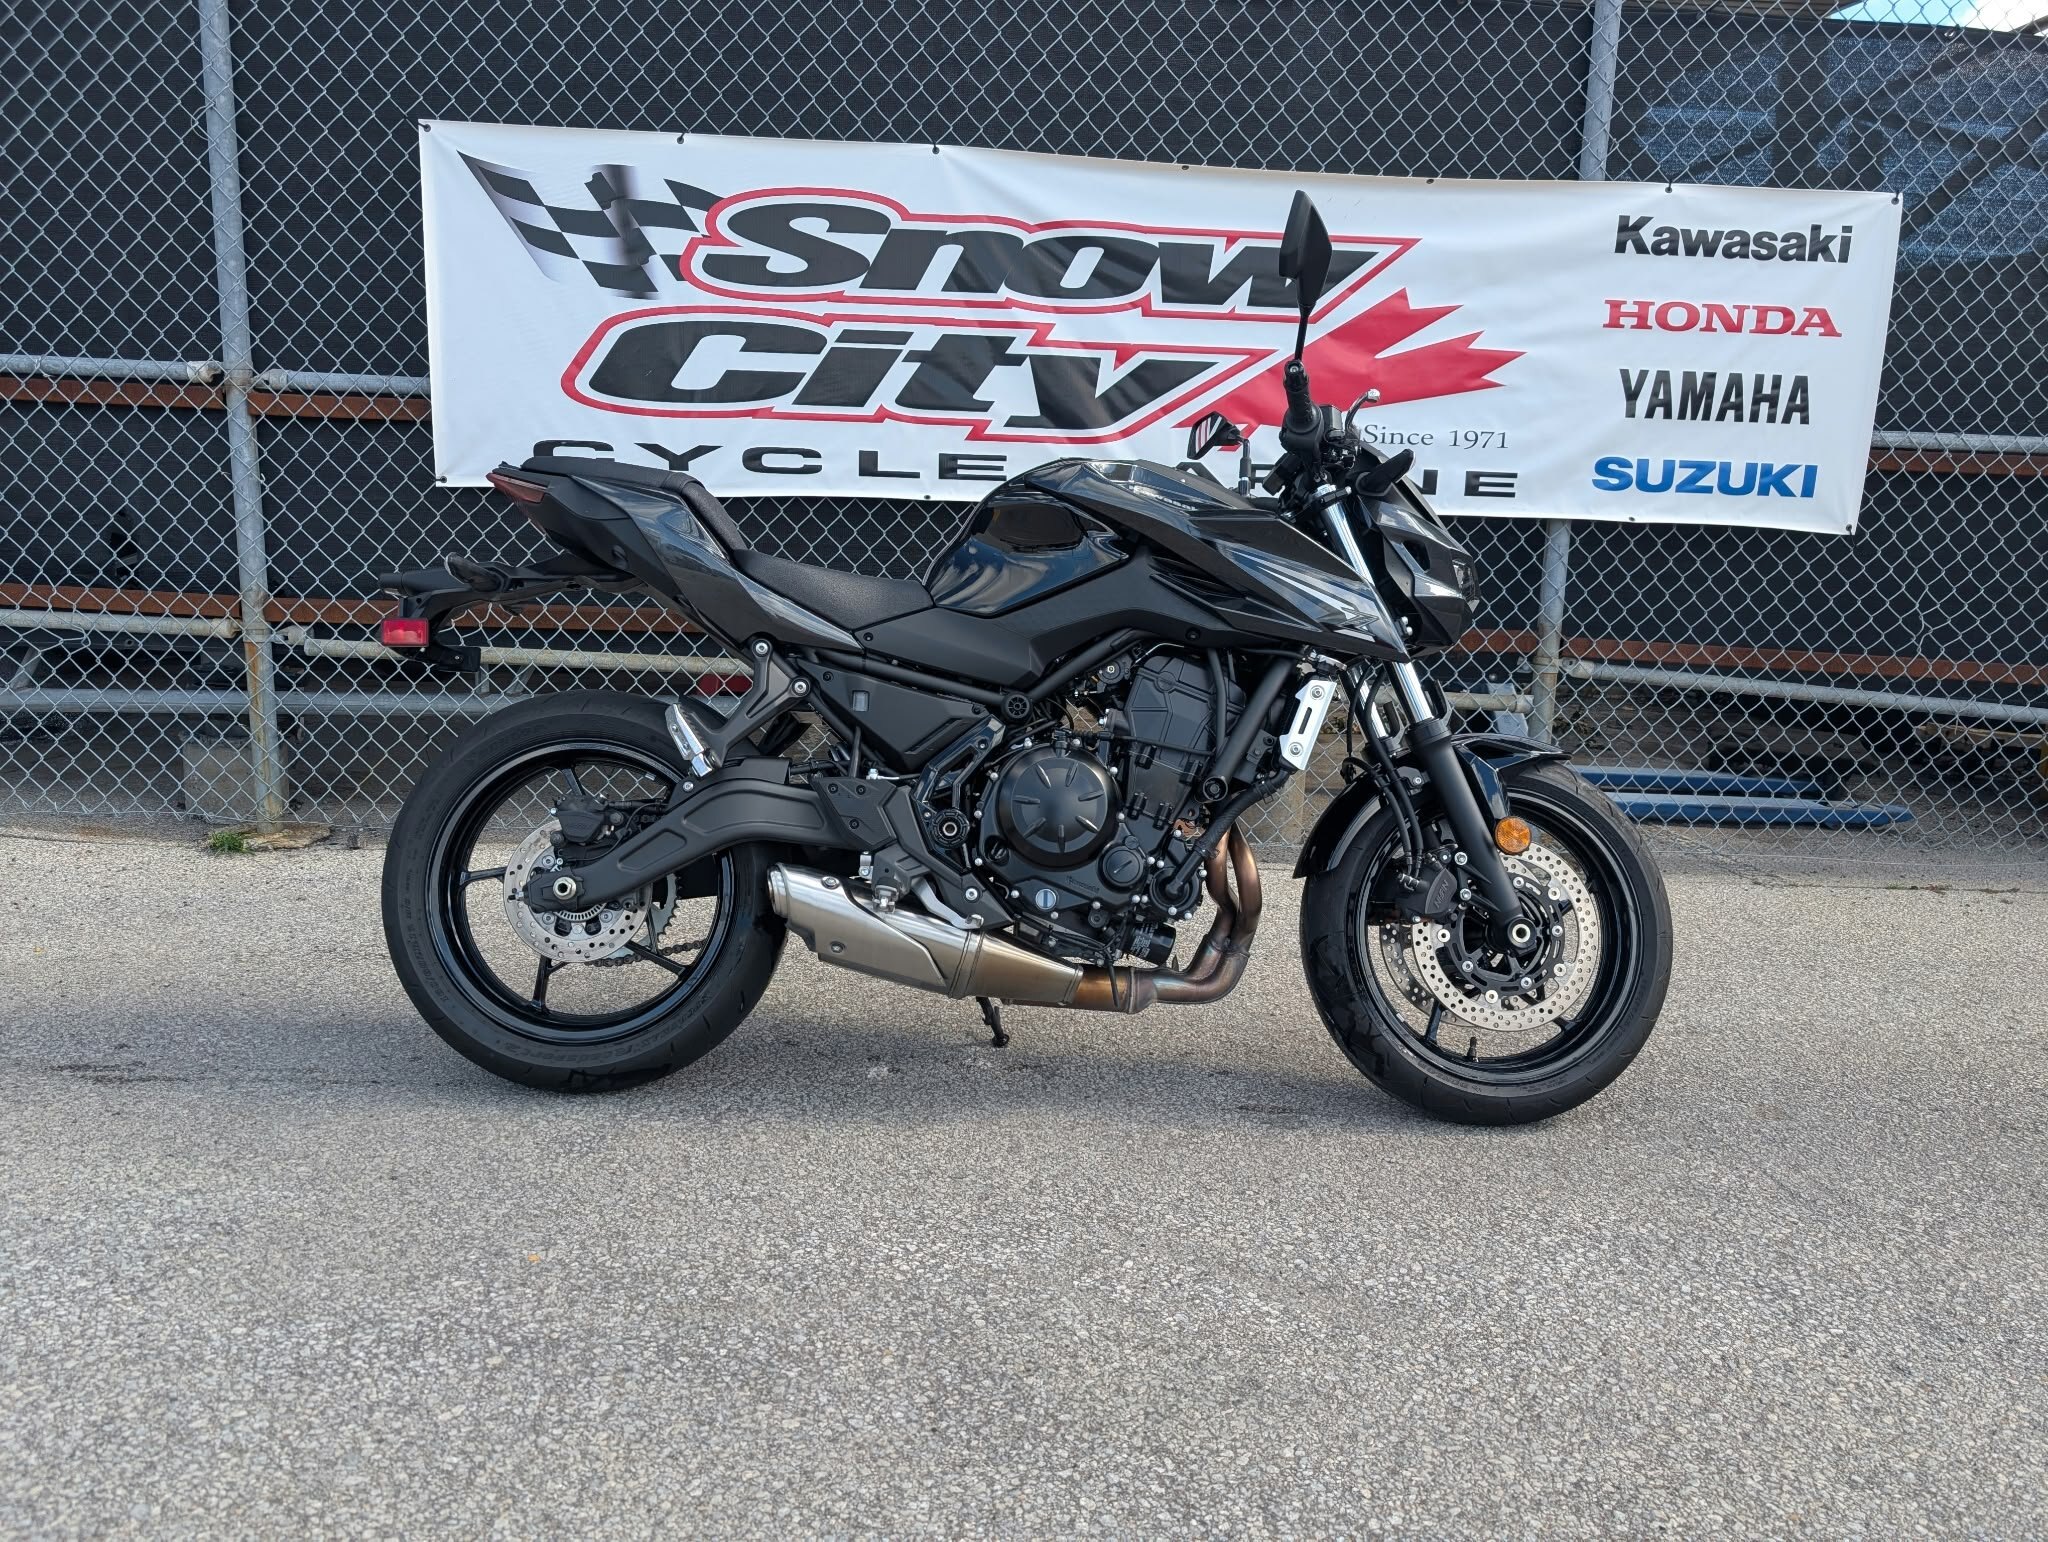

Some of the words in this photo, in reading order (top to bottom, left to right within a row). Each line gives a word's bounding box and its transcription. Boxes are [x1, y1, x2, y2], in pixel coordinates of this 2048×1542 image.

[1613, 215, 1853, 264] Kawasaki
[1602, 299, 1843, 338] HONDA
[588, 320, 1222, 430] City
[1619, 368, 1810, 425] YAMAHA
[1361, 424, 1434, 447] Since
[1448, 429, 1510, 450] 1971
[533, 439, 1007, 482] CYCLE
[1591, 456, 1818, 499] SUZUKI
